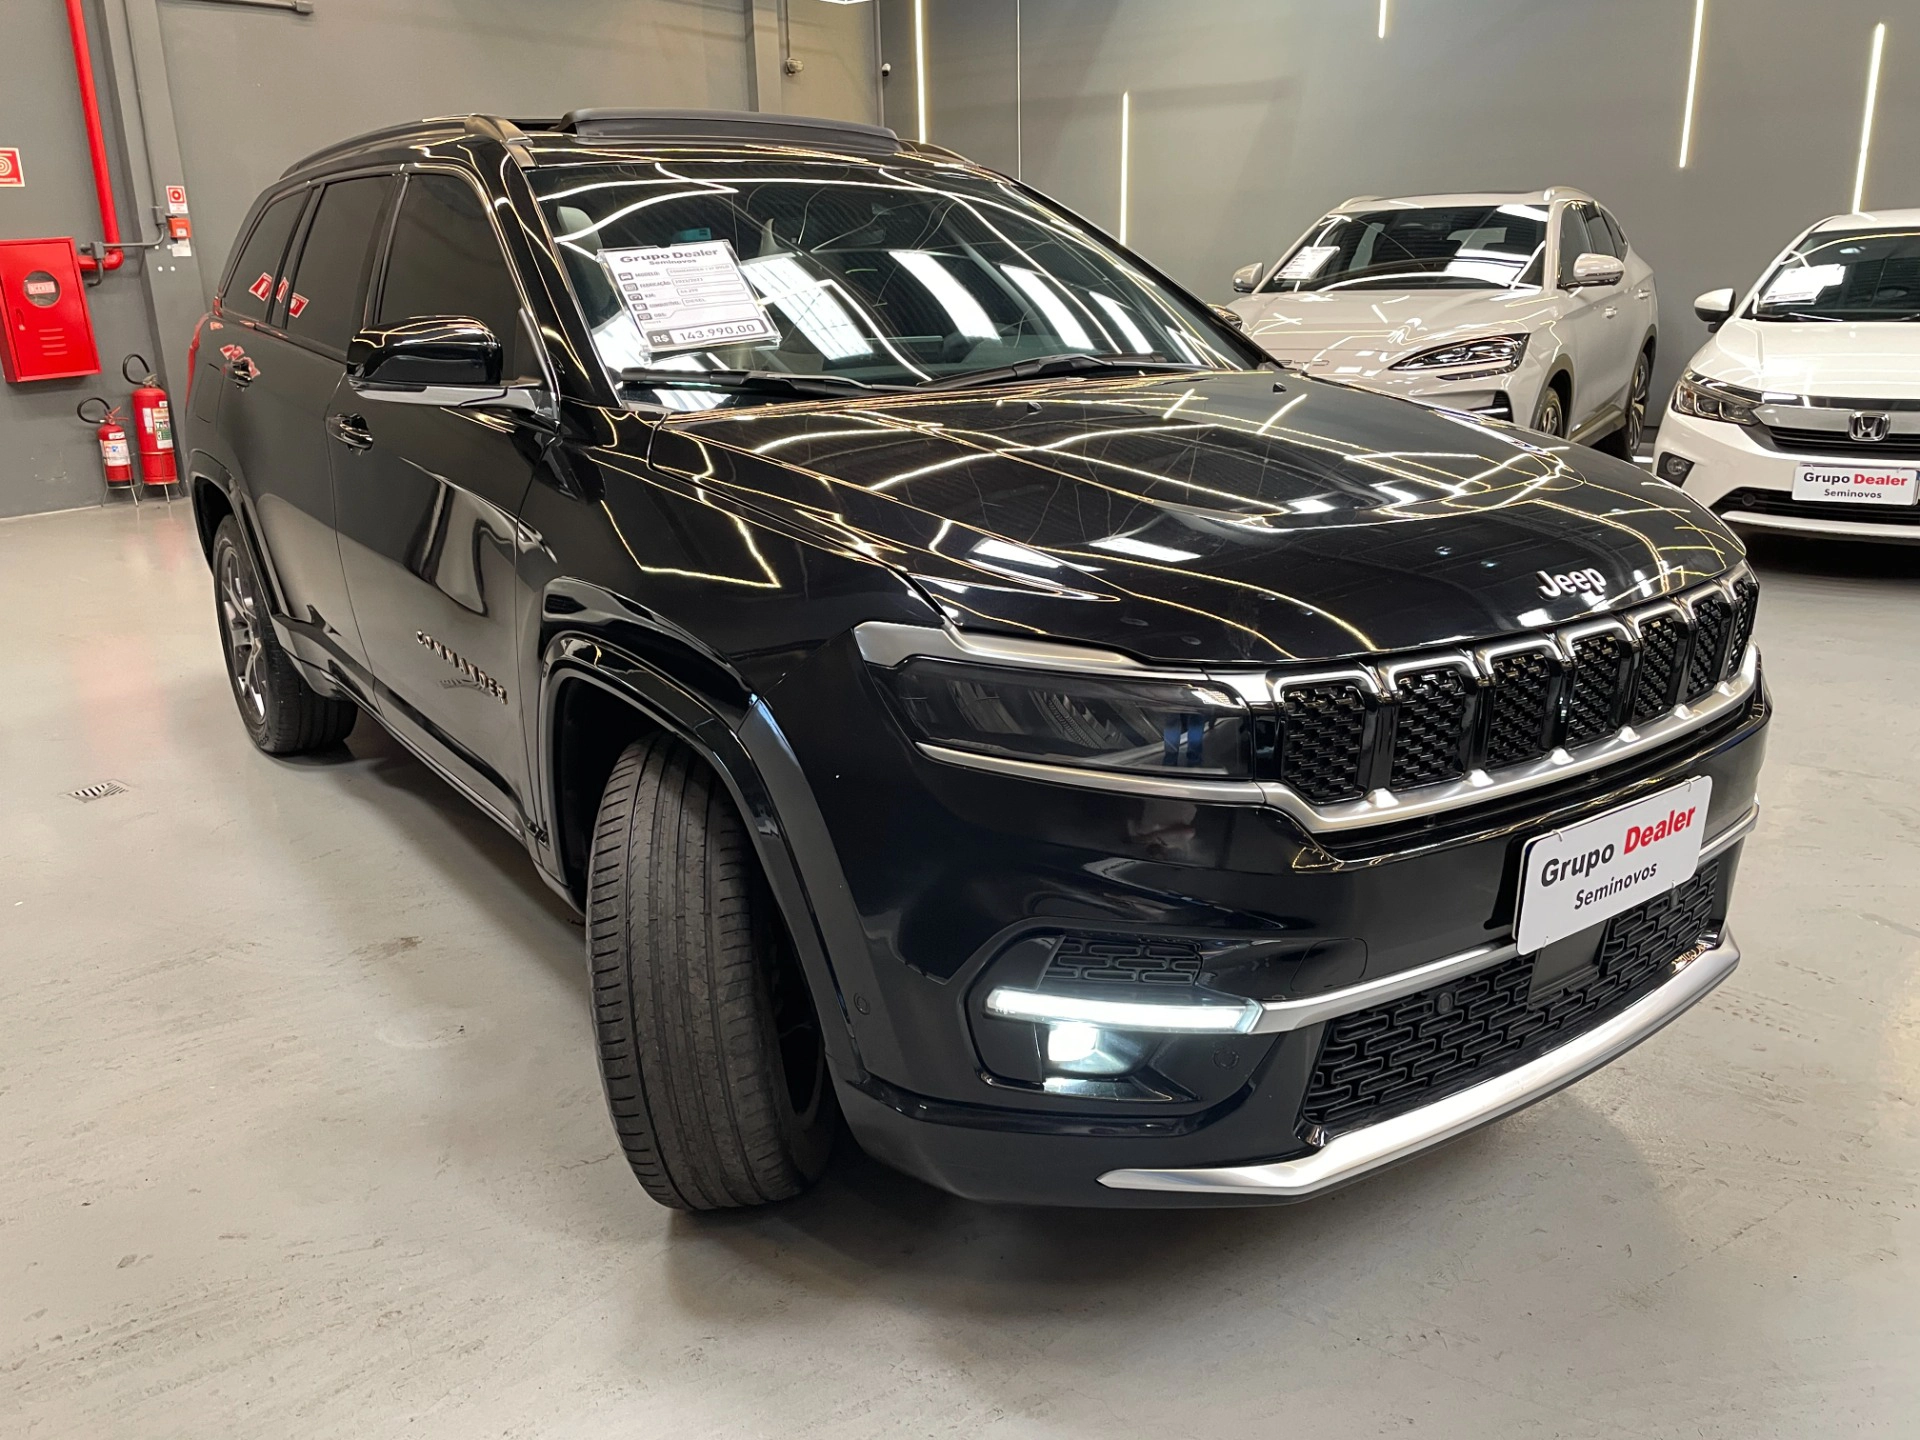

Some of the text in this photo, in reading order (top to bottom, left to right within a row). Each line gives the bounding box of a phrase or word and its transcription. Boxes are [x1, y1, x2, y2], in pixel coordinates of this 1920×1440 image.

[620, 249, 718, 263] Grupo Dealer
[652, 324, 755, 343] R$ 143.990,00
[1804, 472, 1908, 486] Grupo Dealer
[1824, 488, 1882, 498] Seminovos
[1536, 568, 1607, 598] Jeep
[1541, 806, 1696, 887] Grupo Dealer
[1574, 862, 1657, 910] Seminovos
